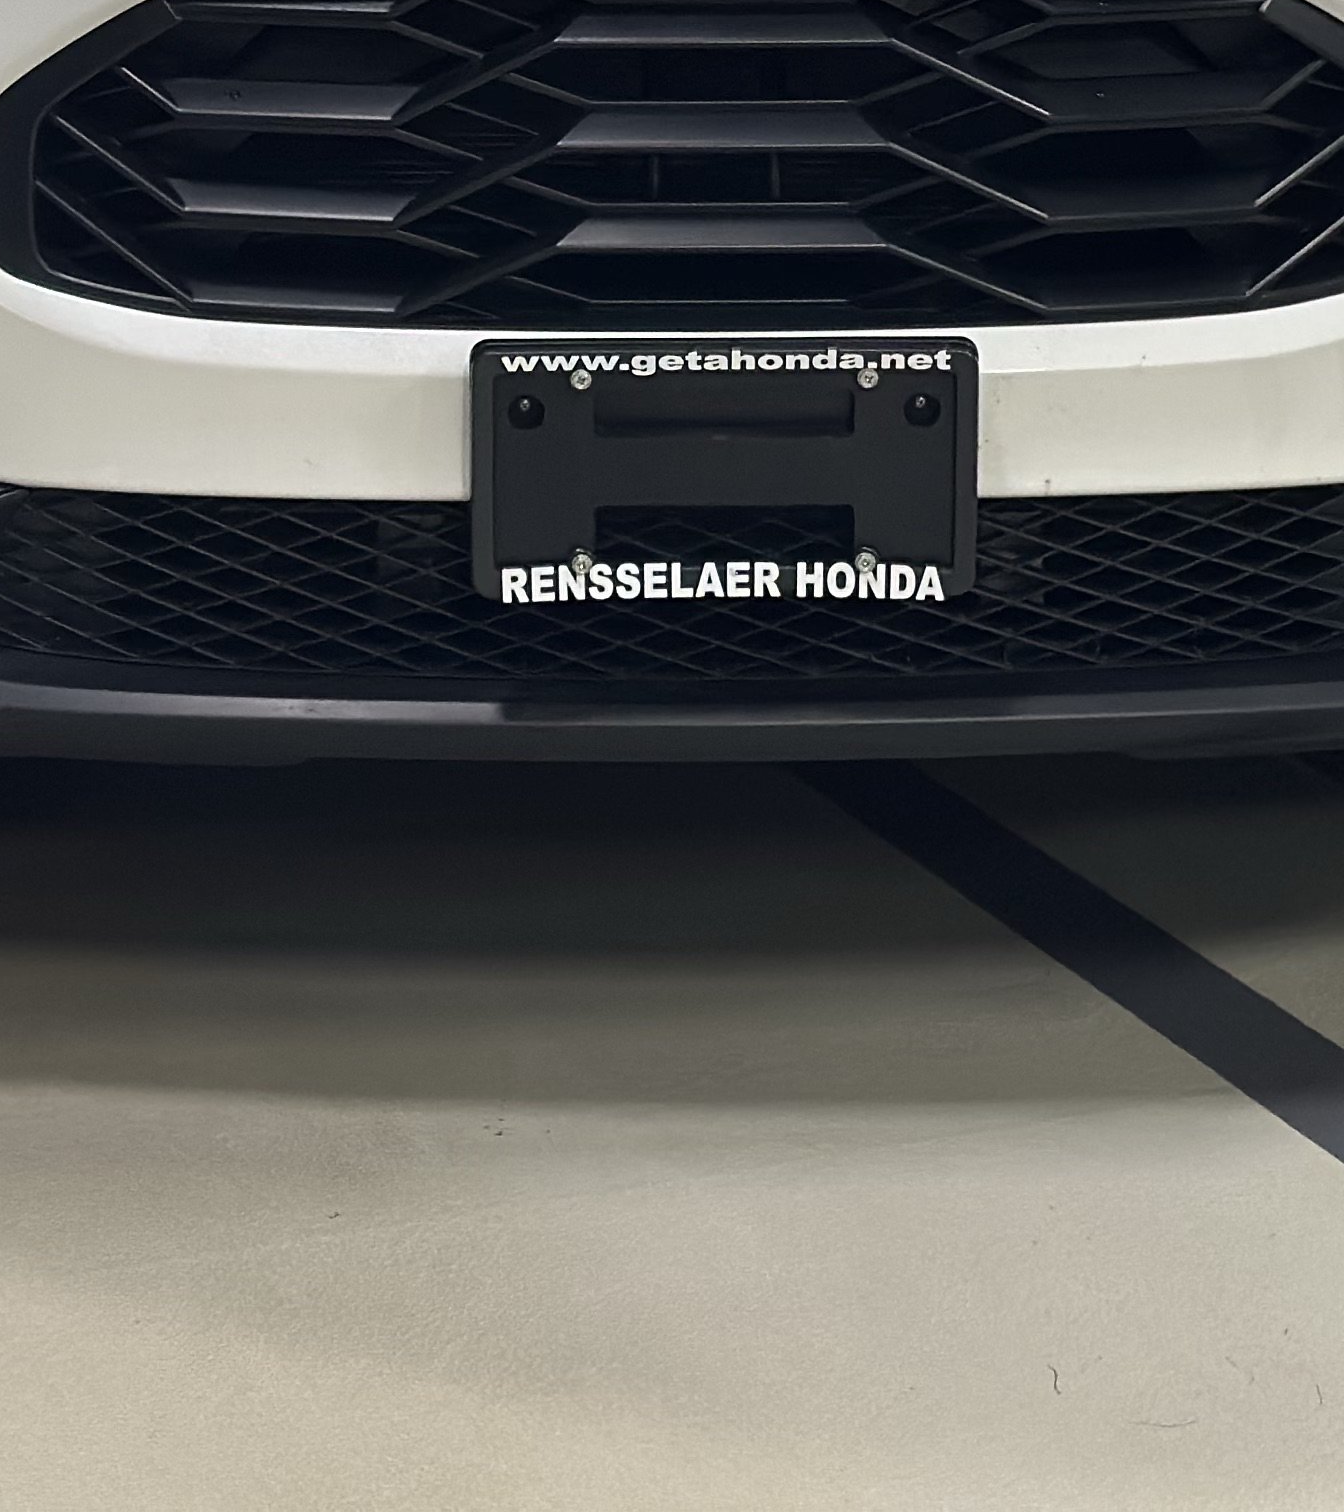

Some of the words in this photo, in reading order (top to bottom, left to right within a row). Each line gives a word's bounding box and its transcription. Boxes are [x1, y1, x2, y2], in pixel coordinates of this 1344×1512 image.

[500, 347, 953, 378] www.getahonda.net
[501, 561, 782, 604] RENSSELAER
[795, 560, 946, 603] HONDA
